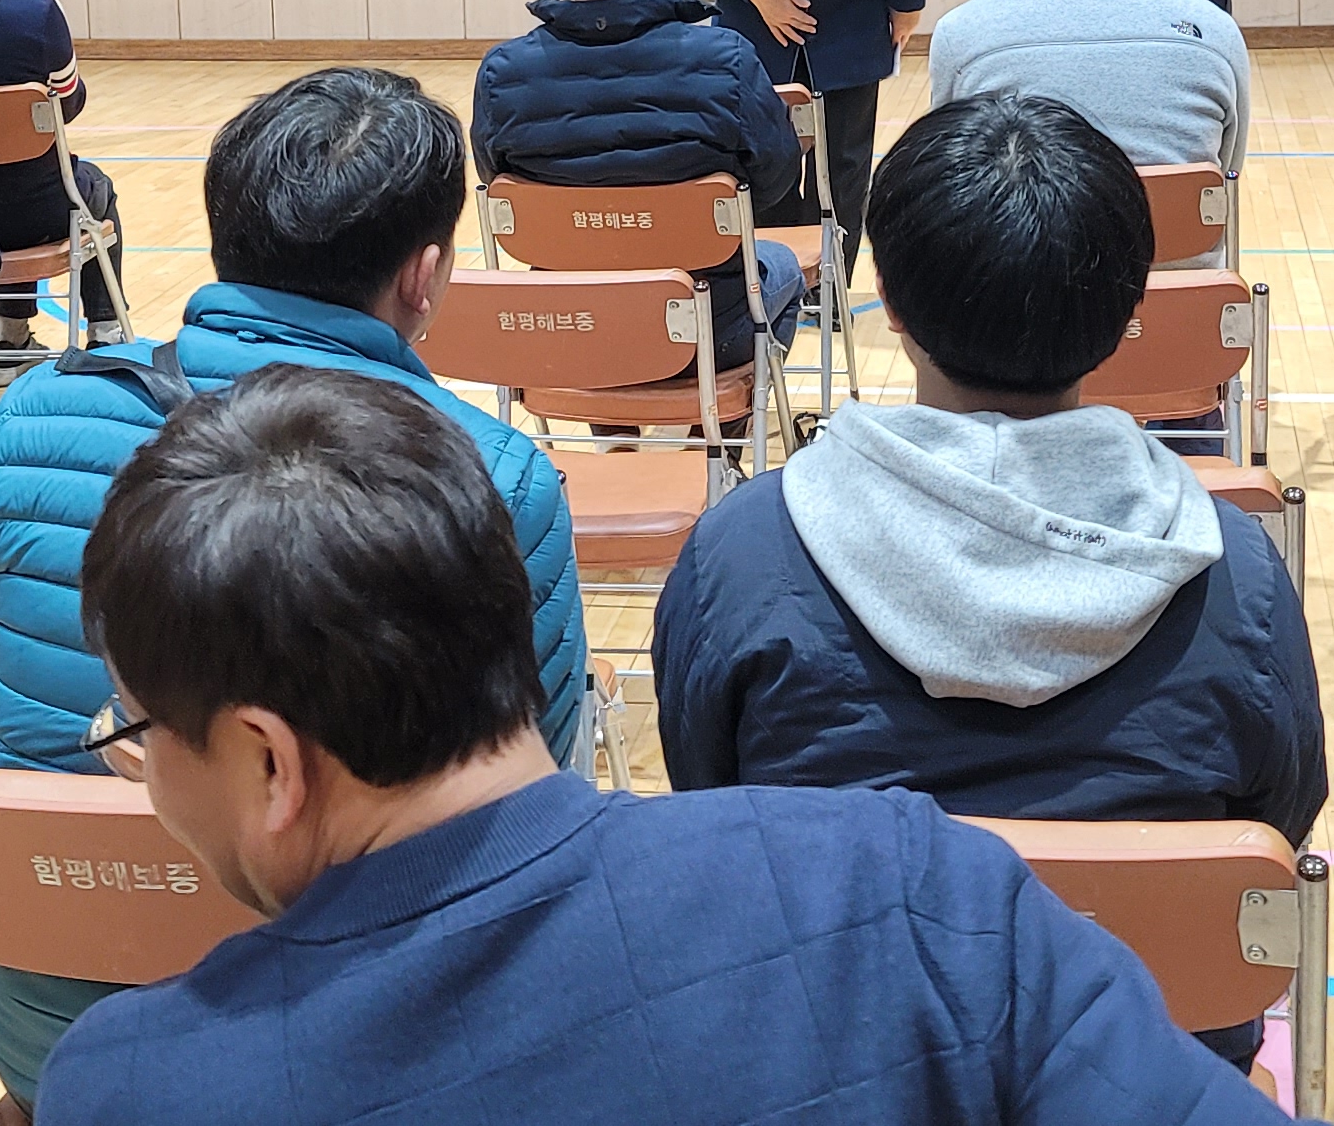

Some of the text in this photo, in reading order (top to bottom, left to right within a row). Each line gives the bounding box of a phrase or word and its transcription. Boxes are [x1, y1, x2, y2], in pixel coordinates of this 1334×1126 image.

[571, 210, 654, 230] 함평해보중
[497, 311, 596, 333] 함평해보중
[30, 854, 200, 895] 함평해보중
